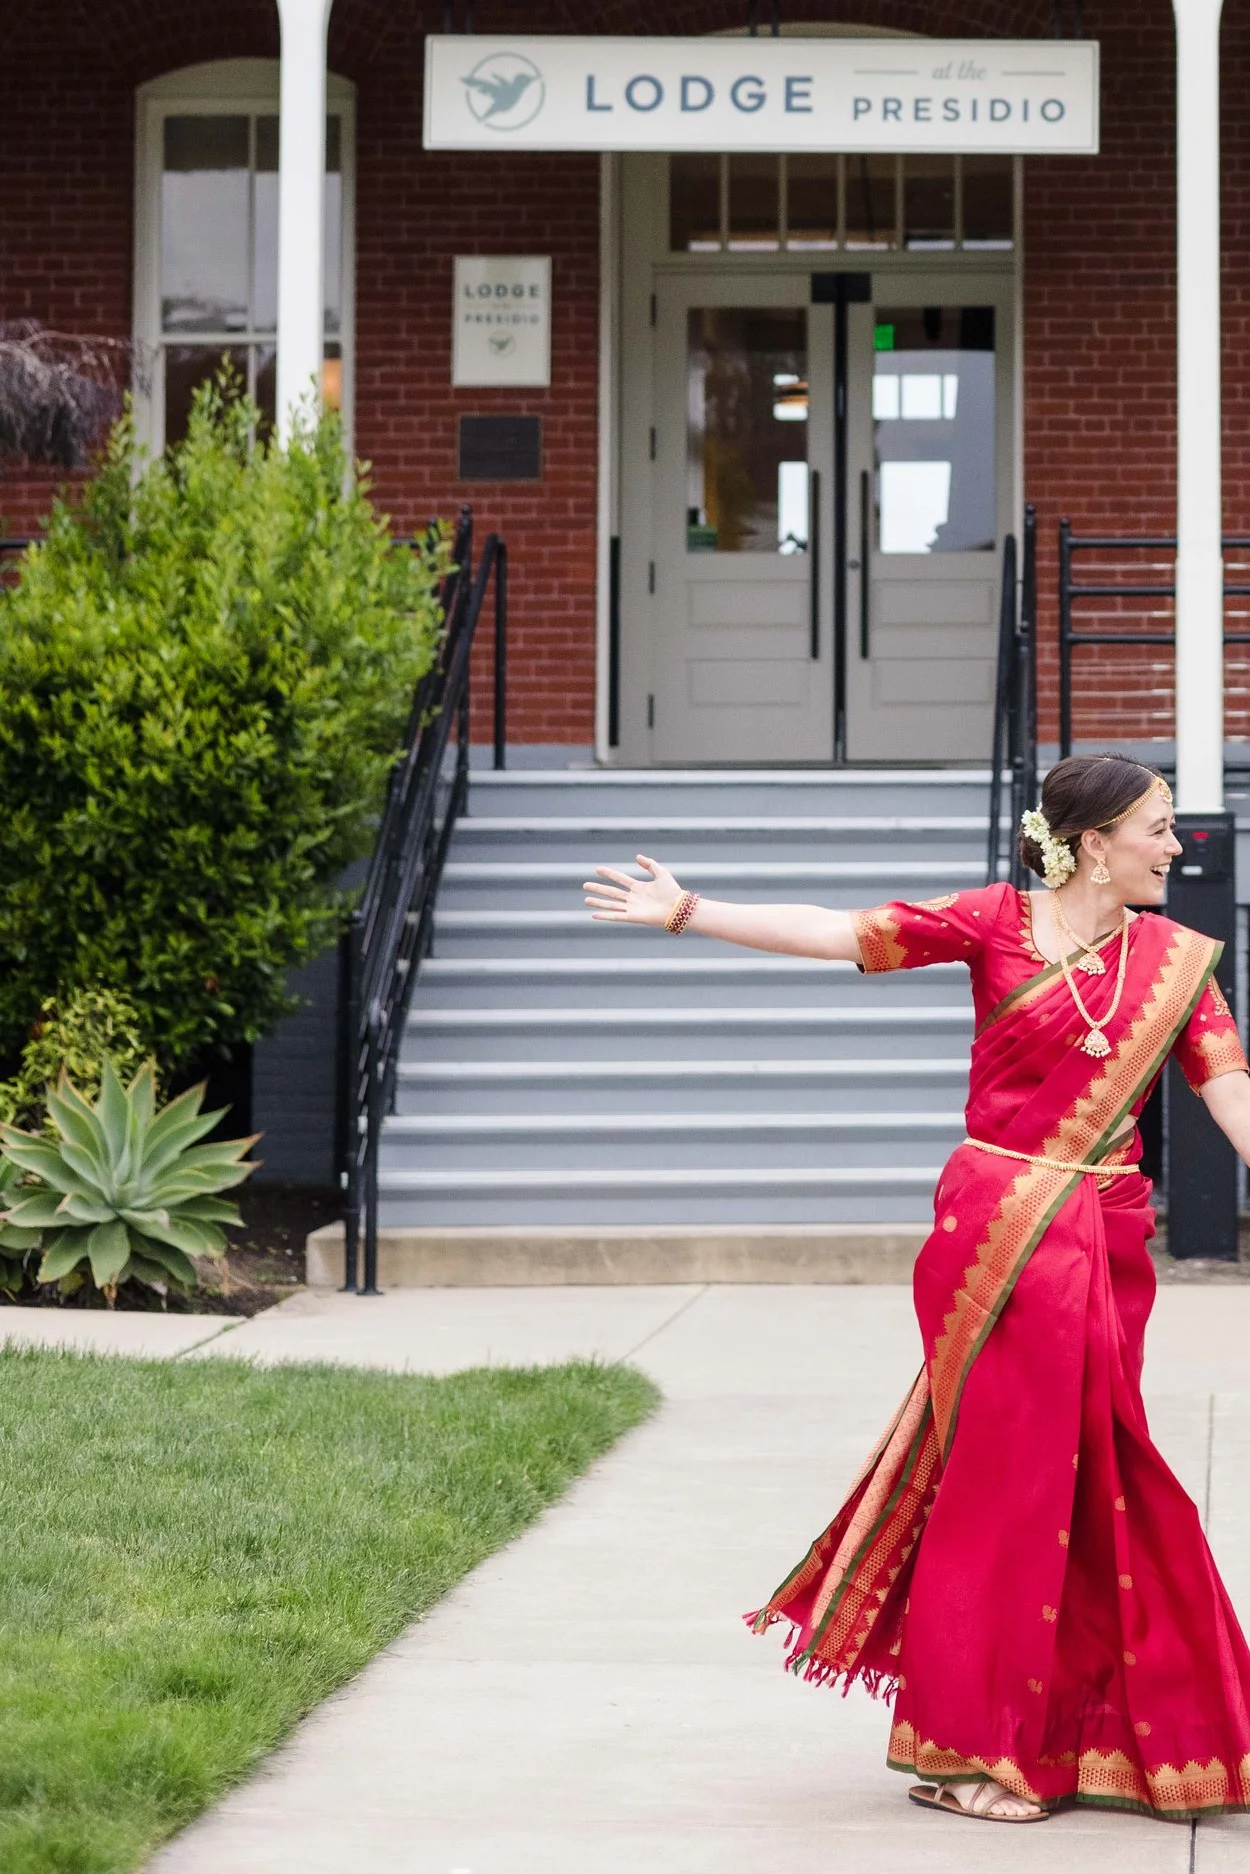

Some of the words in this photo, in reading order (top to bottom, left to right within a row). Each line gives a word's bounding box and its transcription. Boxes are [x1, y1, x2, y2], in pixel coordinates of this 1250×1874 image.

[931, 61, 954, 81] at
[957, 60, 987, 82] the
[586, 74, 814, 113] LODGE
[852, 97, 1066, 123] PRESIDIO
[464, 283, 540, 299] LODGE
